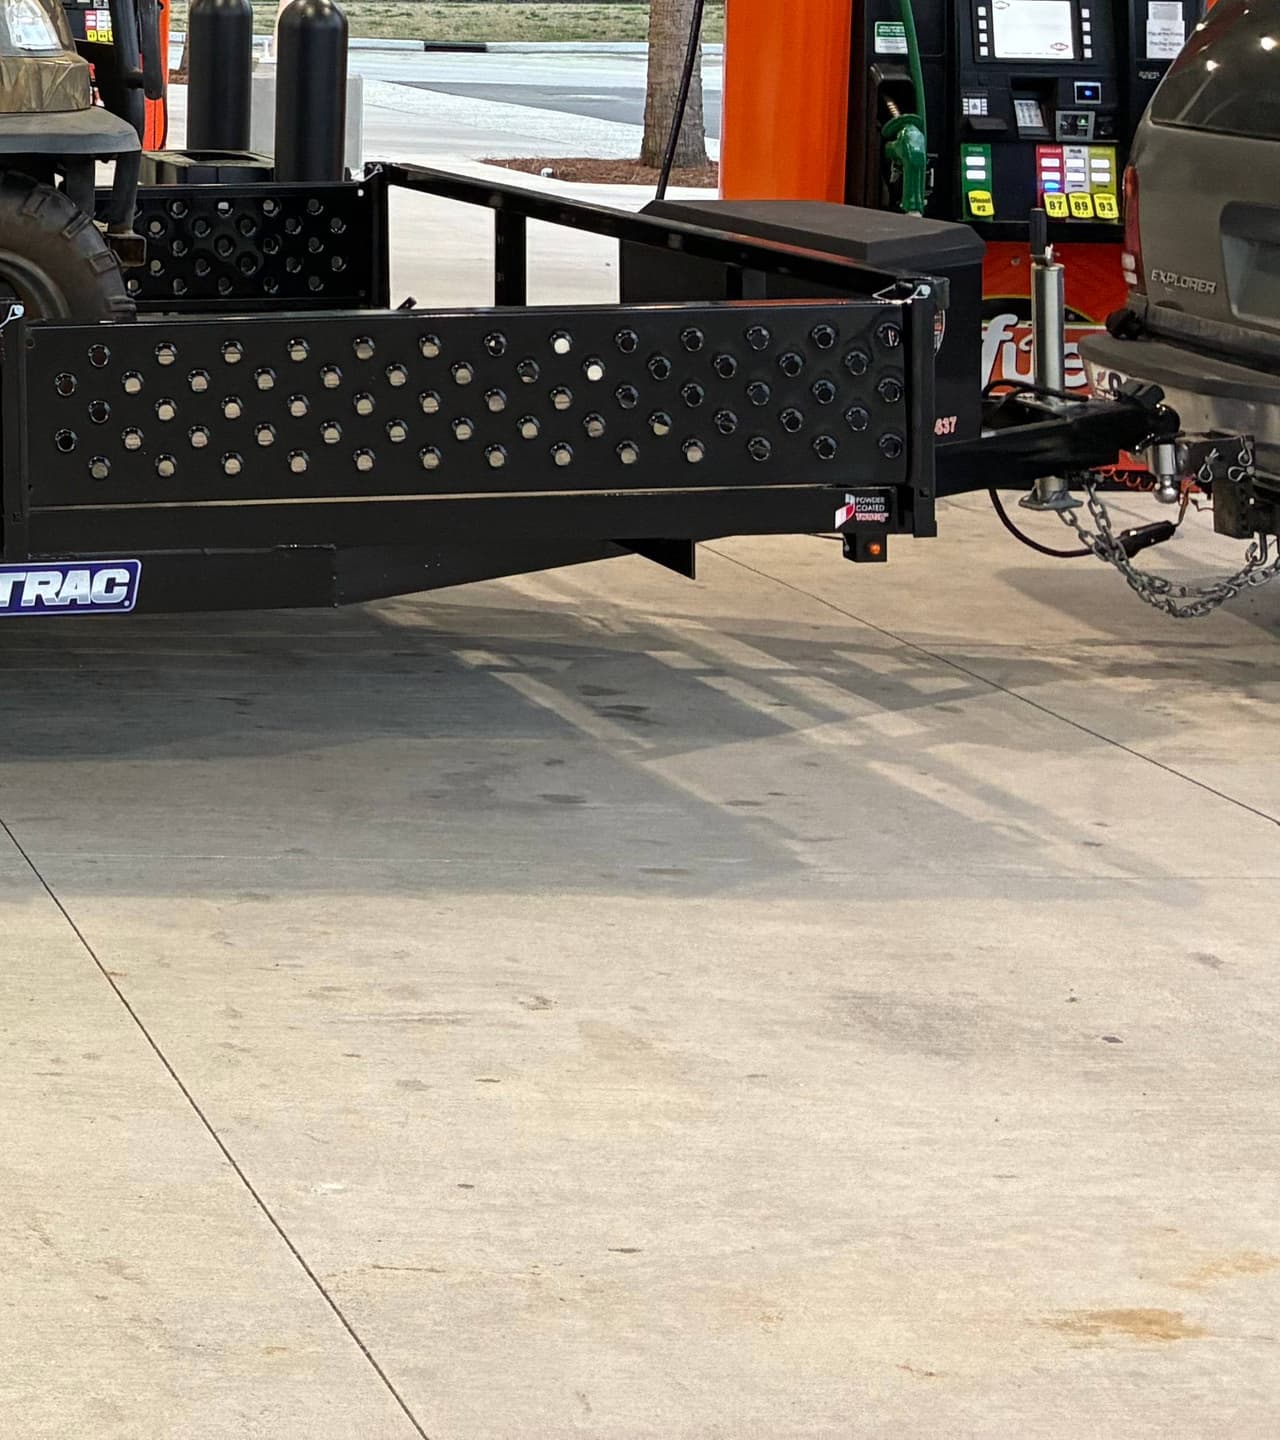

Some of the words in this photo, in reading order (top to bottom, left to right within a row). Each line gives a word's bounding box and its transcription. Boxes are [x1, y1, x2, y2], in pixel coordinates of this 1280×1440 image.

[1049, 200, 1063, 210] 87
[1074, 201, 1088, 211] 89
[1098, 202, 1113, 212] 93
[1151, 269, 1217, 294] EXPLORER
